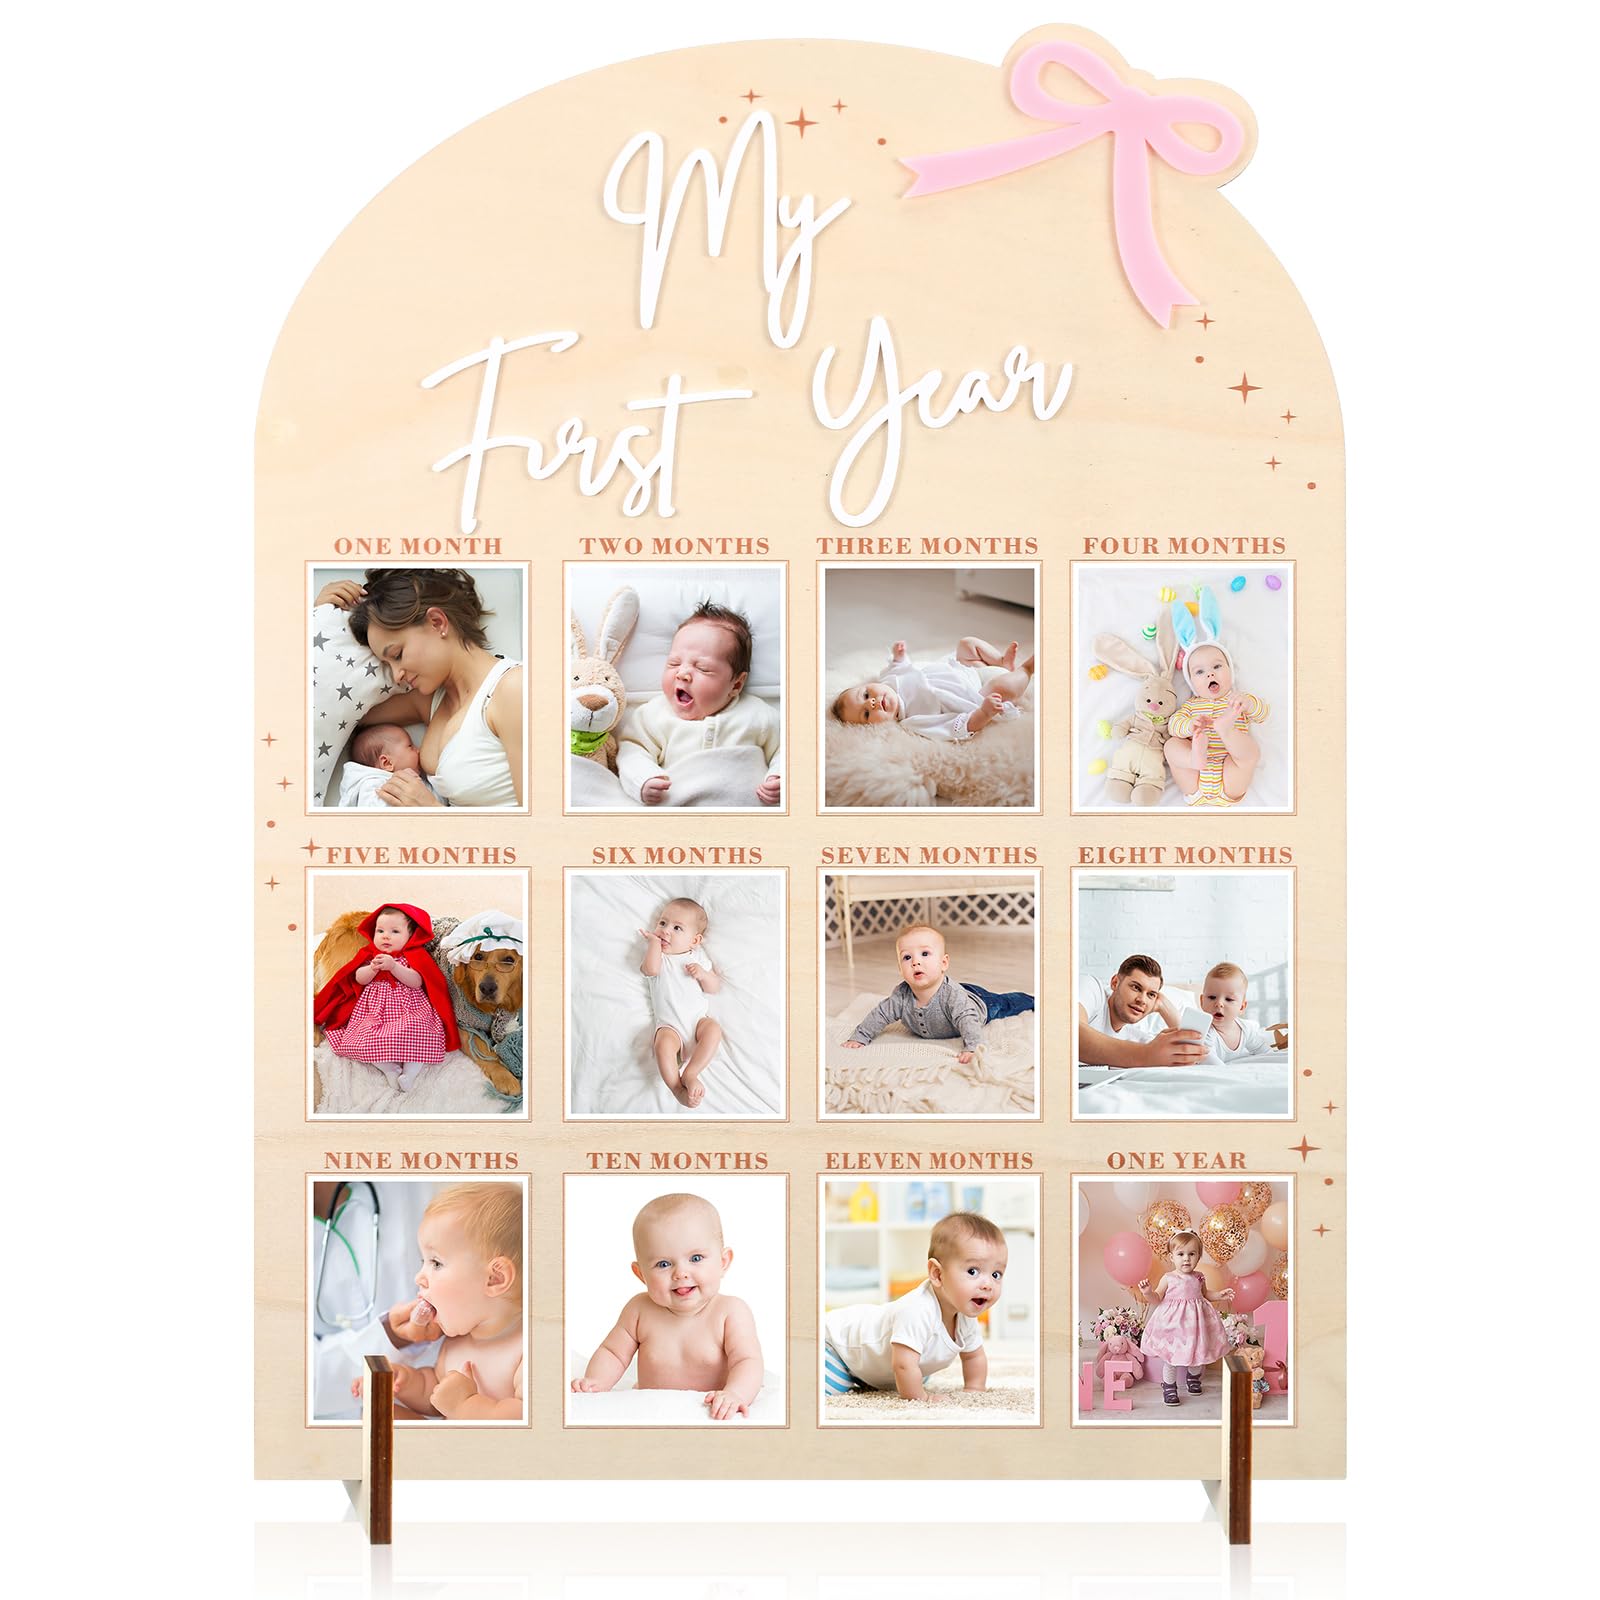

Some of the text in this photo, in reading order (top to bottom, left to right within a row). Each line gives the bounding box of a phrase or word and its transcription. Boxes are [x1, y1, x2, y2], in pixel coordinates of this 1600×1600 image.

[602, 110, 852, 350] My
[420, 315, 1073, 534] First Year
[333, 537, 502, 555] ONE MONTH
[579, 537, 770, 555] TWO MONTHS
[816, 537, 1039, 555] THREE MONTHS
[1082, 537, 1286, 555] FOUR MONTHS
[326, 846, 517, 864] FIVE MONTHS
[592, 846, 763, 864] SIX MONTHS
[821, 846, 1038, 864] SEVEN MONTHS
[1078, 846, 1294, 864] EIGHT MONTHS
[323, 1151, 519, 1169] NINE MONTHS
[586, 1151, 769, 1169] TEN MONTHS
[825, 1151, 1034, 1169] ELEVEN MONTHS
[1107, 1151, 1248, 1169] ONE YEAR
